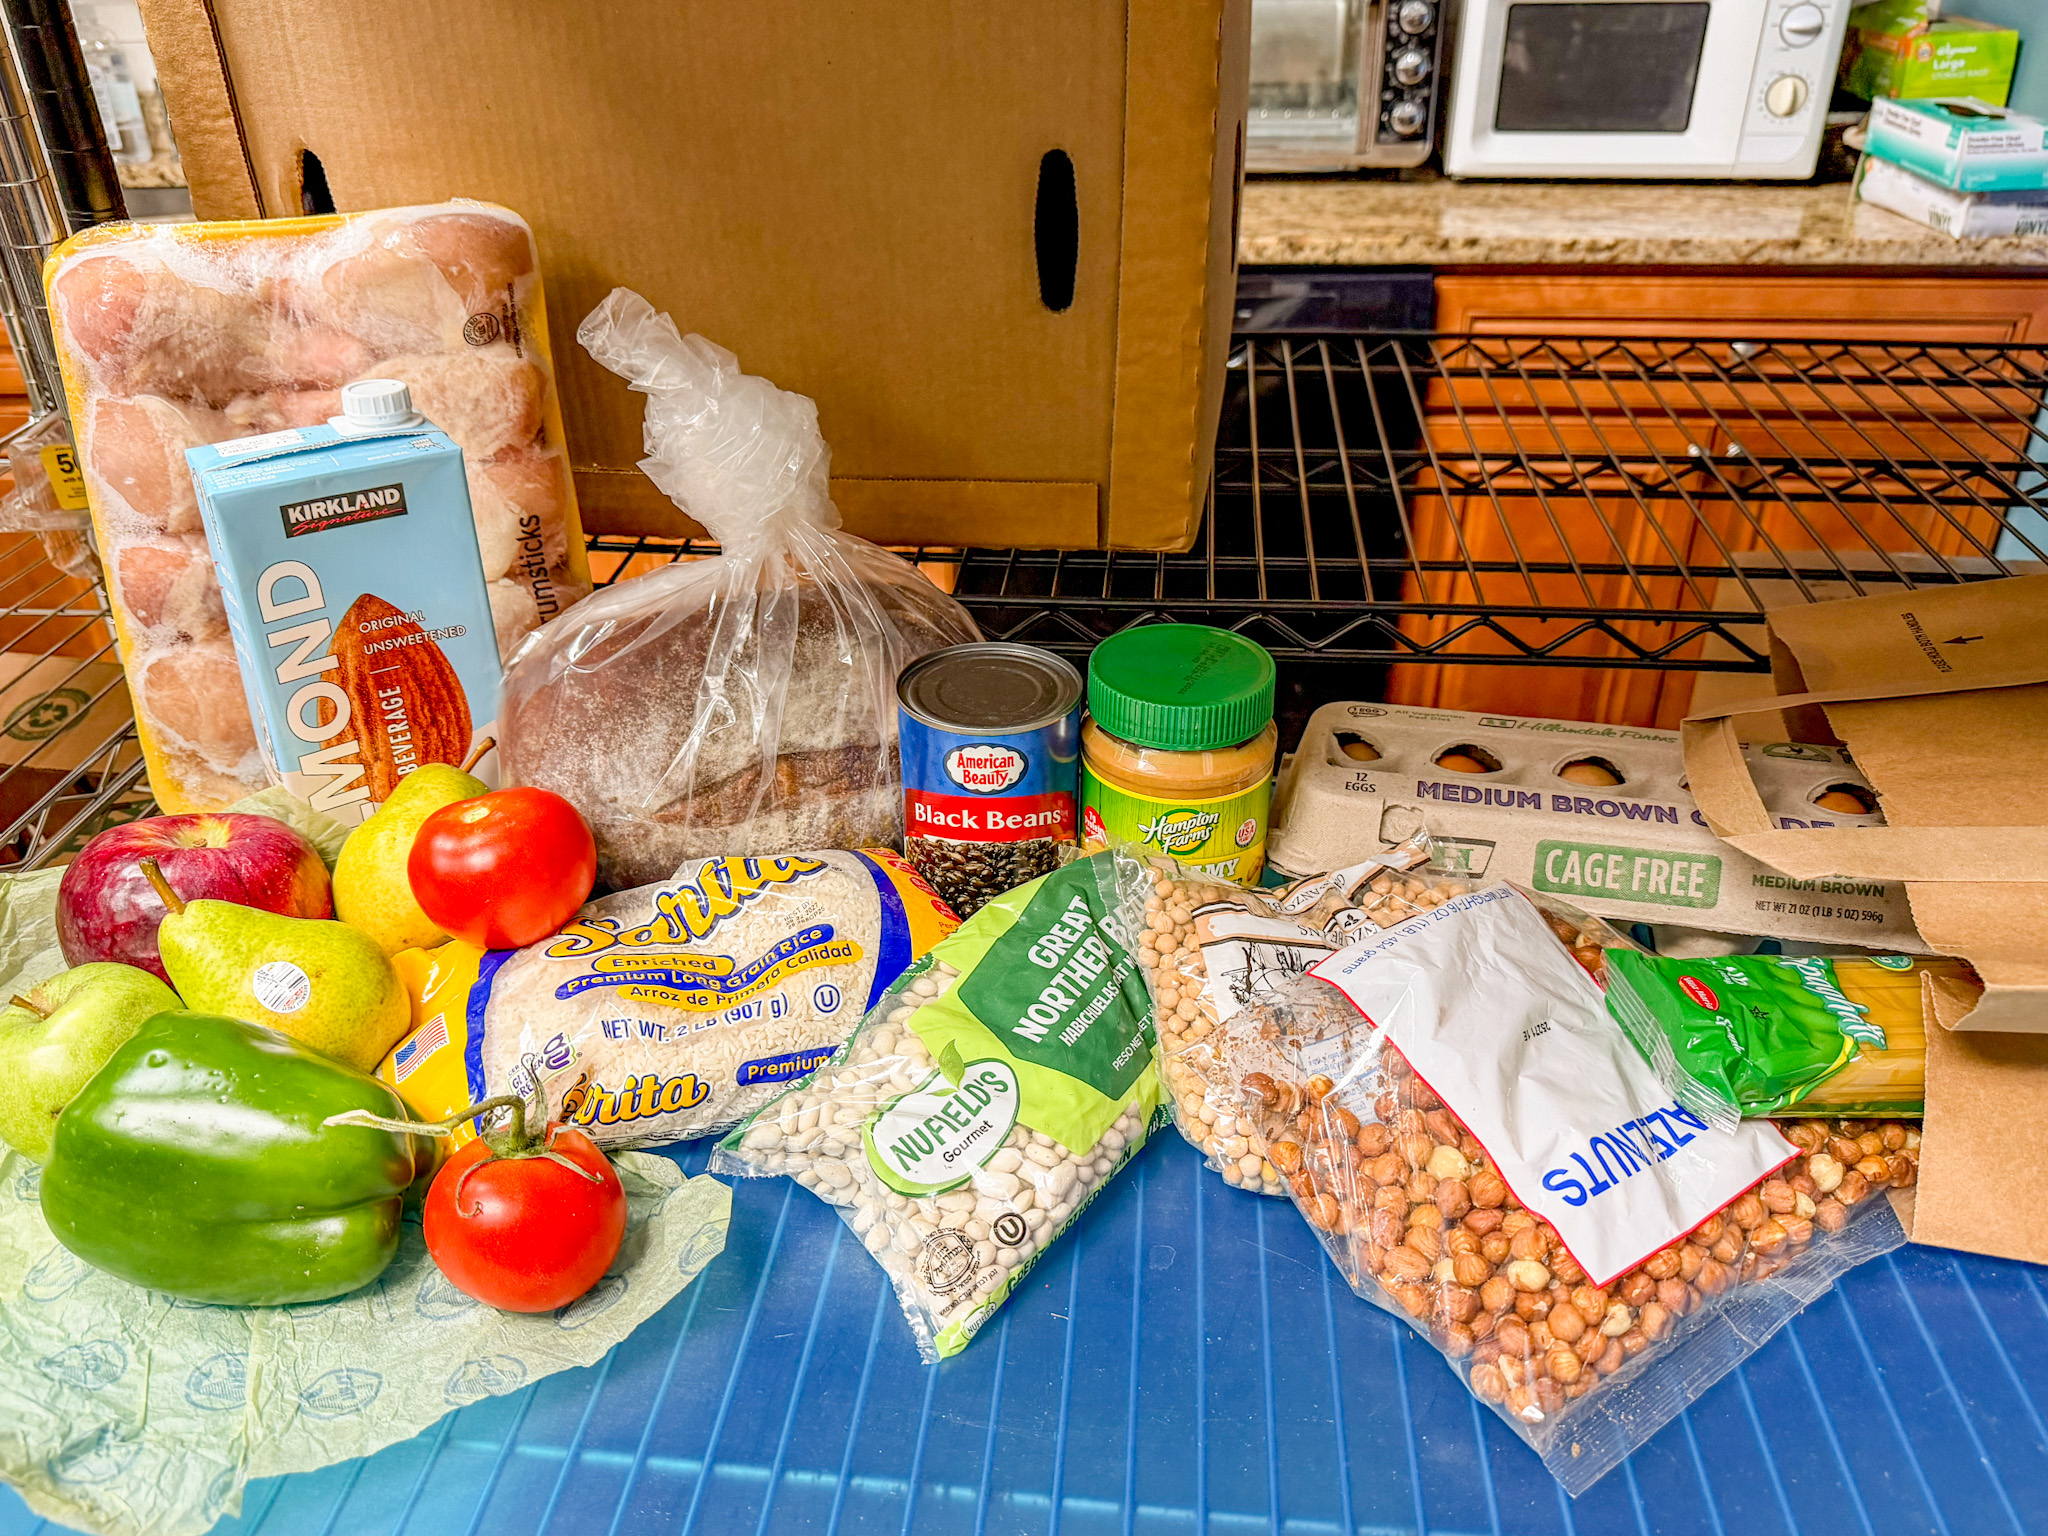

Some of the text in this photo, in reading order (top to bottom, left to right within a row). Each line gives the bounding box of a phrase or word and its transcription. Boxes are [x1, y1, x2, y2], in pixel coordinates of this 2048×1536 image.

[1933, 58, 1966, 72] Large
[287, 488, 401, 523] KIRKLAND
[292, 508, 403, 537] Signature
[359, 610, 426, 634] ORIGINAL
[363, 625, 467, 655] UNSWEETENED
[256, 559, 378, 828] MOND
[378, 685, 420, 776] BEVERAGE
[1516, 720, 1678, 744] Hillandale Farms
[956, 751, 1015, 772] American
[962, 767, 1010, 788] Beauty
[1345, 781, 1377, 794] EGGS
[1355, 772, 1368, 783] 12
[914, 802, 1061, 831] Black Beans
[1417, 779, 1542, 813] MEDIUM
[1551, 793, 1679, 826] BROWN
[1142, 811, 1220, 844] Hampton
[1162, 825, 1212, 854] Farms
[1238, 825, 1254, 839] USA
[1544, 847, 1707, 901] CAGE FREE
[1752, 874, 1885, 898] MEDIUM BROWN
[1494, 886, 1511, 899] NET
[804, 901, 818, 915] 2027
[1426, 905, 1448, 923] OZ.
[1755, 900, 1771, 911] NET
[1773, 902, 1787, 914] WT
[1789, 903, 1797, 914] 21
[1799, 904, 1810, 915] OZ
[1822, 907, 1833, 918] LB
[1836, 907, 1842, 918] 5
[1844, 908, 1859, 921] OZ)
[1861, 910, 1884, 924] 596g
[1028, 895, 1094, 970] GREAT
[1375, 934, 1397, 953] 454
[566, 927, 824, 993] Premium Long Grain Rice
[612, 955, 717, 972] Enriched
[629, 942, 853, 1007] Arroz de Primera Calidad
[1341, 948, 1375, 977] grams
[600, 990, 790, 1045] NET WT. 2 LB (907 g)
[1058, 980, 1120, 1048] HABICHUELAS
[1111, 1045, 1135, 1072] PESO
[1131, 1031, 1144, 1053] NET
[746, 1053, 828, 1081] Premium
[888, 1068, 1010, 1173] NUFIELD'S
[943, 1119, 994, 1164] Gourmet
[1541, 1099, 1707, 1207] AZELNUTS
[966, 1305, 995, 1335] NUFIELD'S
